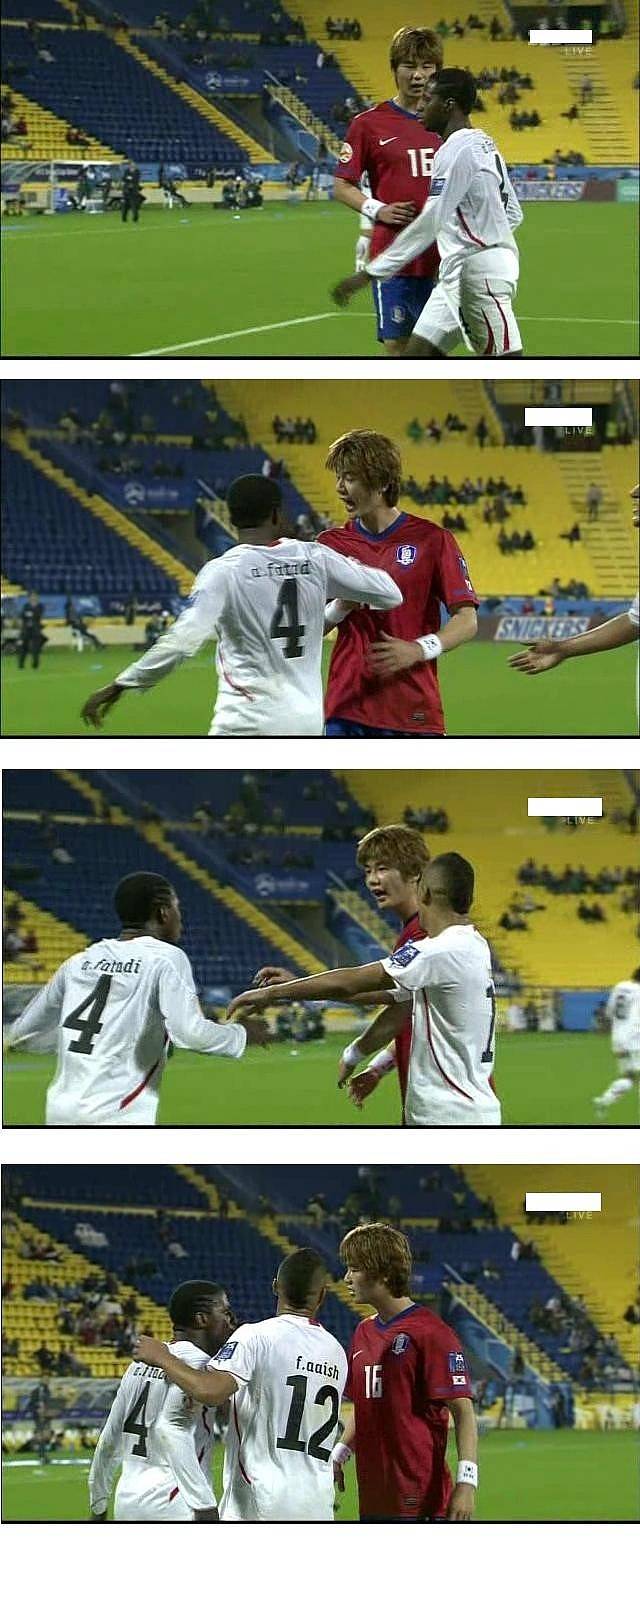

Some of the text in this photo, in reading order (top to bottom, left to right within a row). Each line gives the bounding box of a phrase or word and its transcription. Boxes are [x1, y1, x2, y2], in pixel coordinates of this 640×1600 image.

[407, 148, 435, 177] 16
[270, 578, 305, 658] 4
[500, 618, 587, 639] SNICKERS
[62, 973, 113, 1055] 4
[296, 1355, 339, 1381] f.aaish
[364, 1364, 383, 1400] 16
[122, 1380, 148, 1458] 4
[276, 1374, 340, 1462] 12
